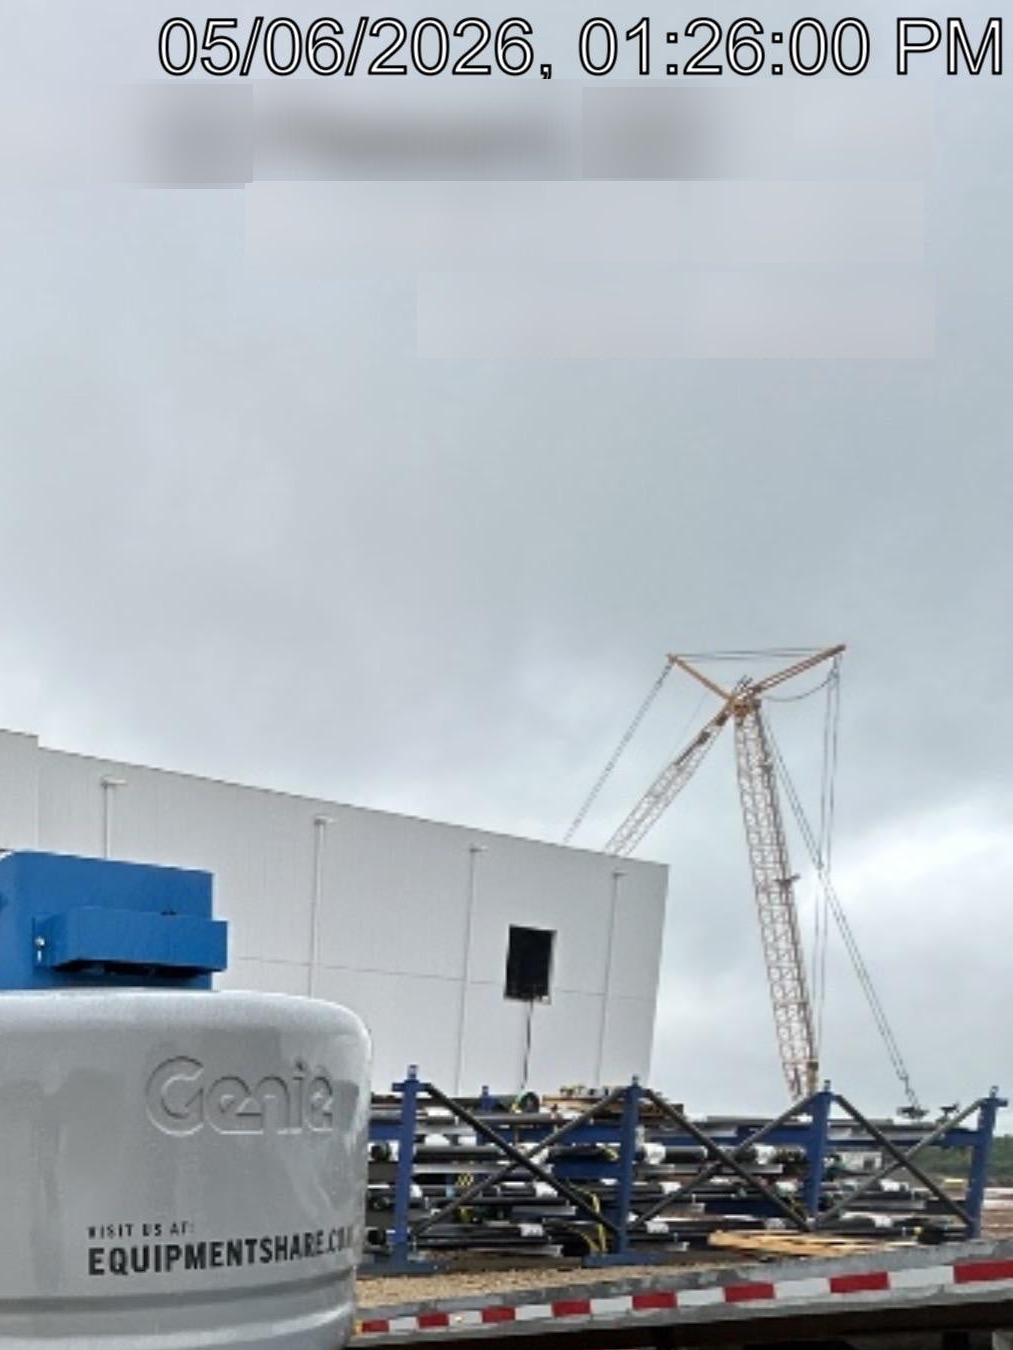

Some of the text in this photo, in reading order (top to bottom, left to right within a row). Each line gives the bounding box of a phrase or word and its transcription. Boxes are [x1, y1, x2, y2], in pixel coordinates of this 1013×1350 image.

[145, 1055, 333, 1138] Genie
[88, 1223, 134, 1239] VISIT
[142, 1222, 162, 1237] US
